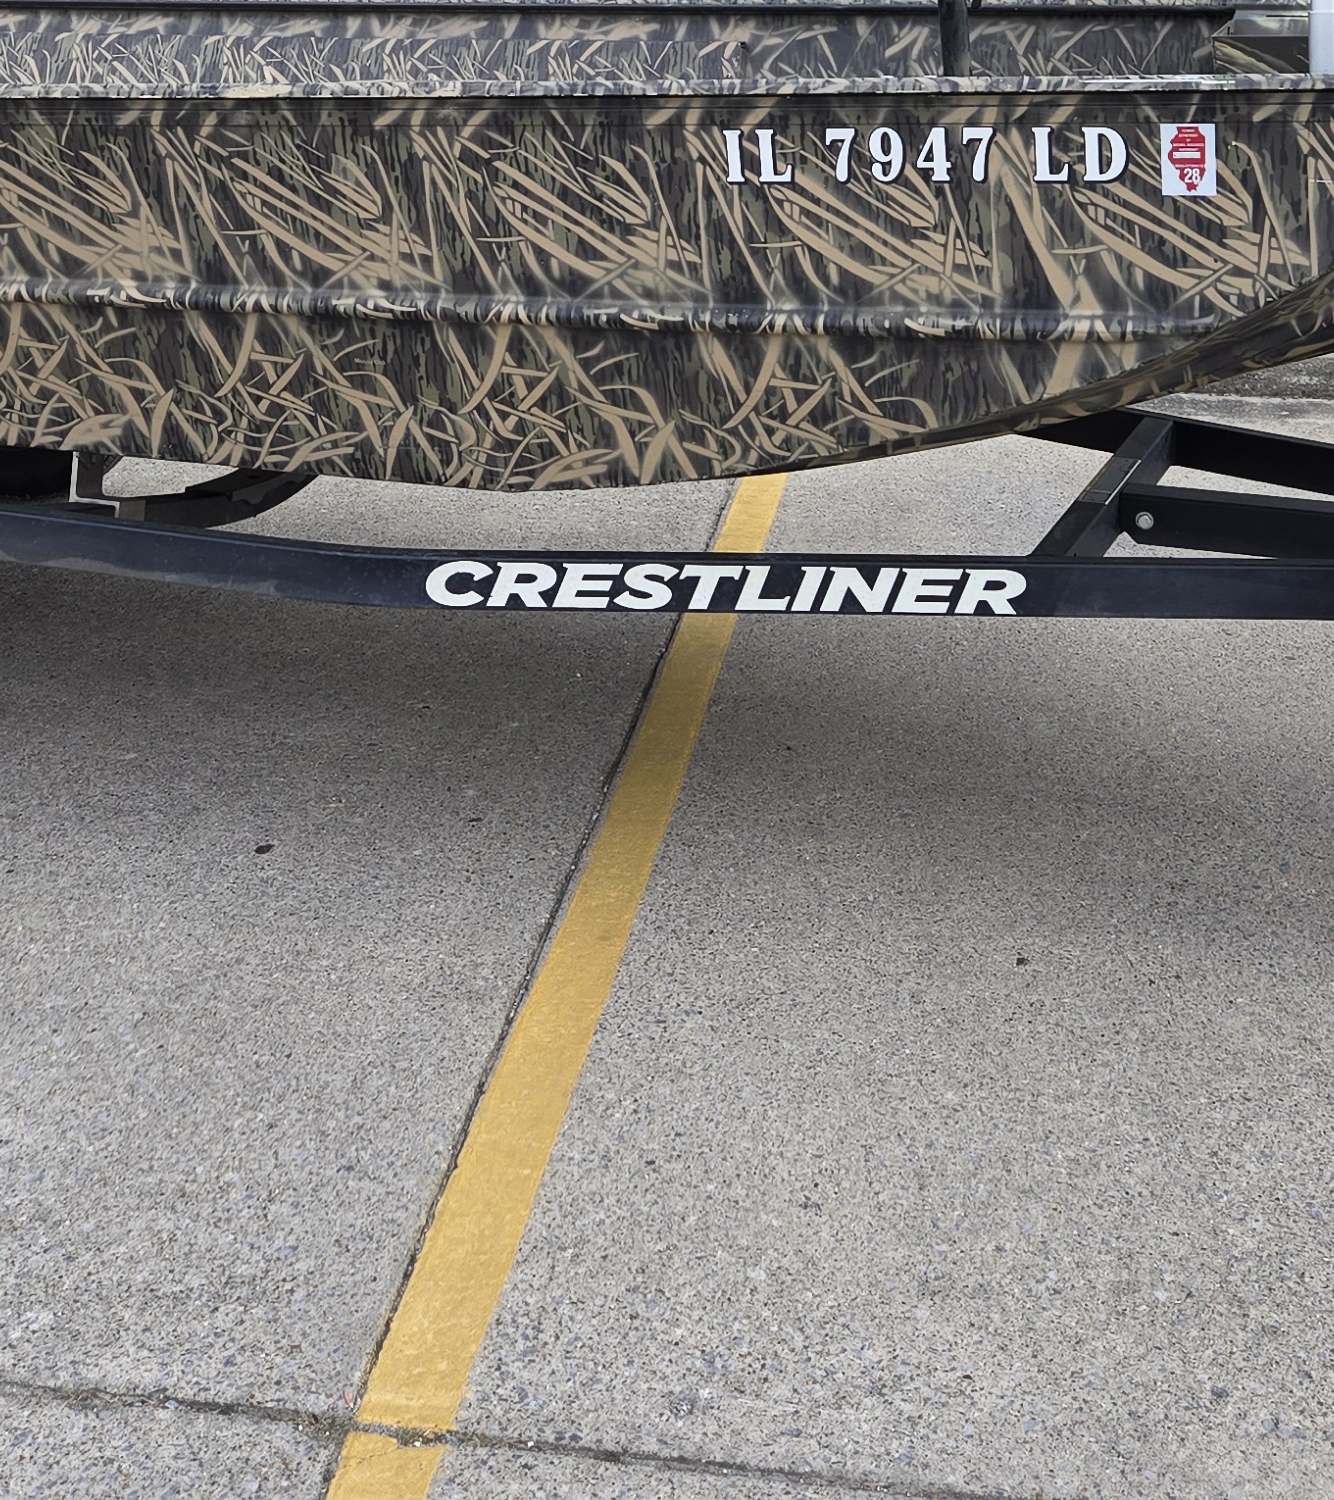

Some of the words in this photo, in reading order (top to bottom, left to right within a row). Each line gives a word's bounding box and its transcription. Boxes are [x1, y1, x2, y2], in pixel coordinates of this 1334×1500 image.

[722, 127, 793, 184] IL
[824, 126, 997, 184] 7947
[1031, 126, 1129, 184] LD
[1184, 167, 1201, 184] 28
[424, 560, 1028, 616] CRESTLINER
